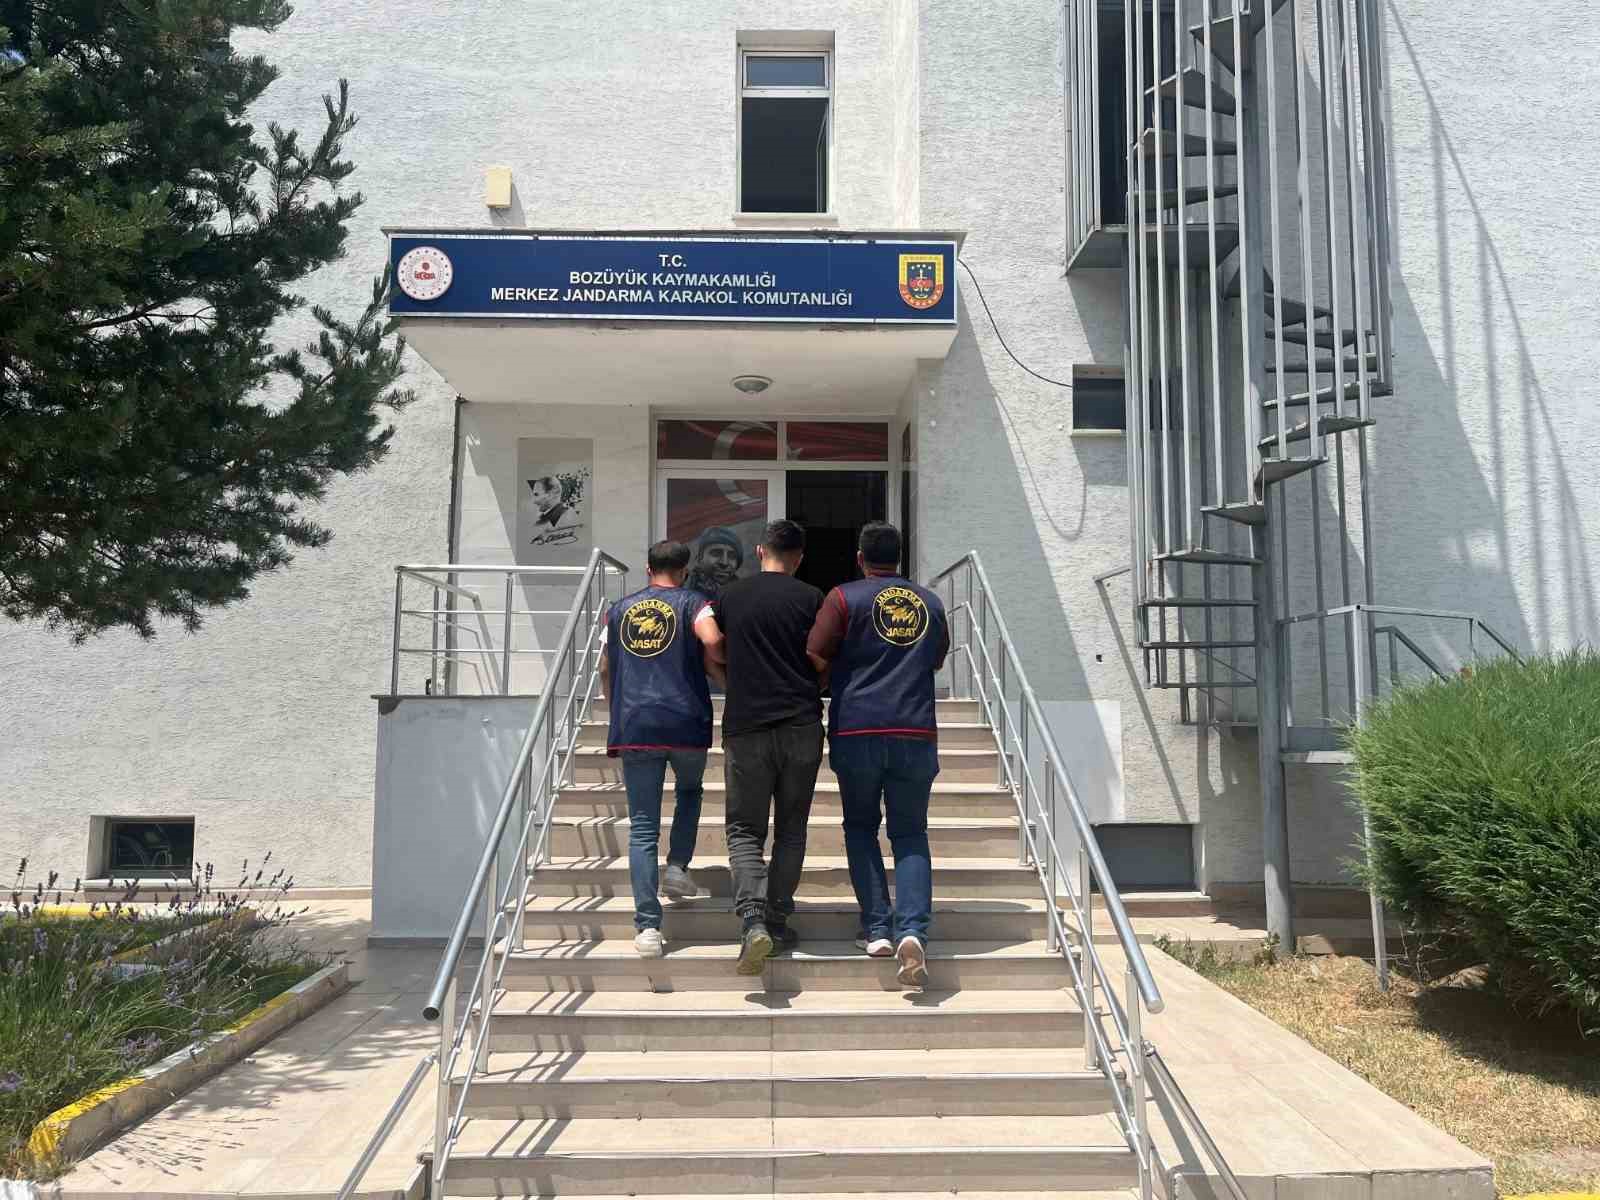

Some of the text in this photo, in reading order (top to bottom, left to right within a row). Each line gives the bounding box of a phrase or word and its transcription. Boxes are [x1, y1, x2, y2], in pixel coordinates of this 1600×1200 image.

[659, 254, 687, 268] T.C.
[569, 268, 776, 288] BOZÜYÜK KAYMAKAMLIĞI
[491, 287, 853, 306] MERKEZ JANDARMA KARAKOL KOMUTANLIĞI
[876, 589, 922, 607] JANDARMA
[886, 627, 916, 637] JASAT
[630, 639, 662, 649] JASAT
